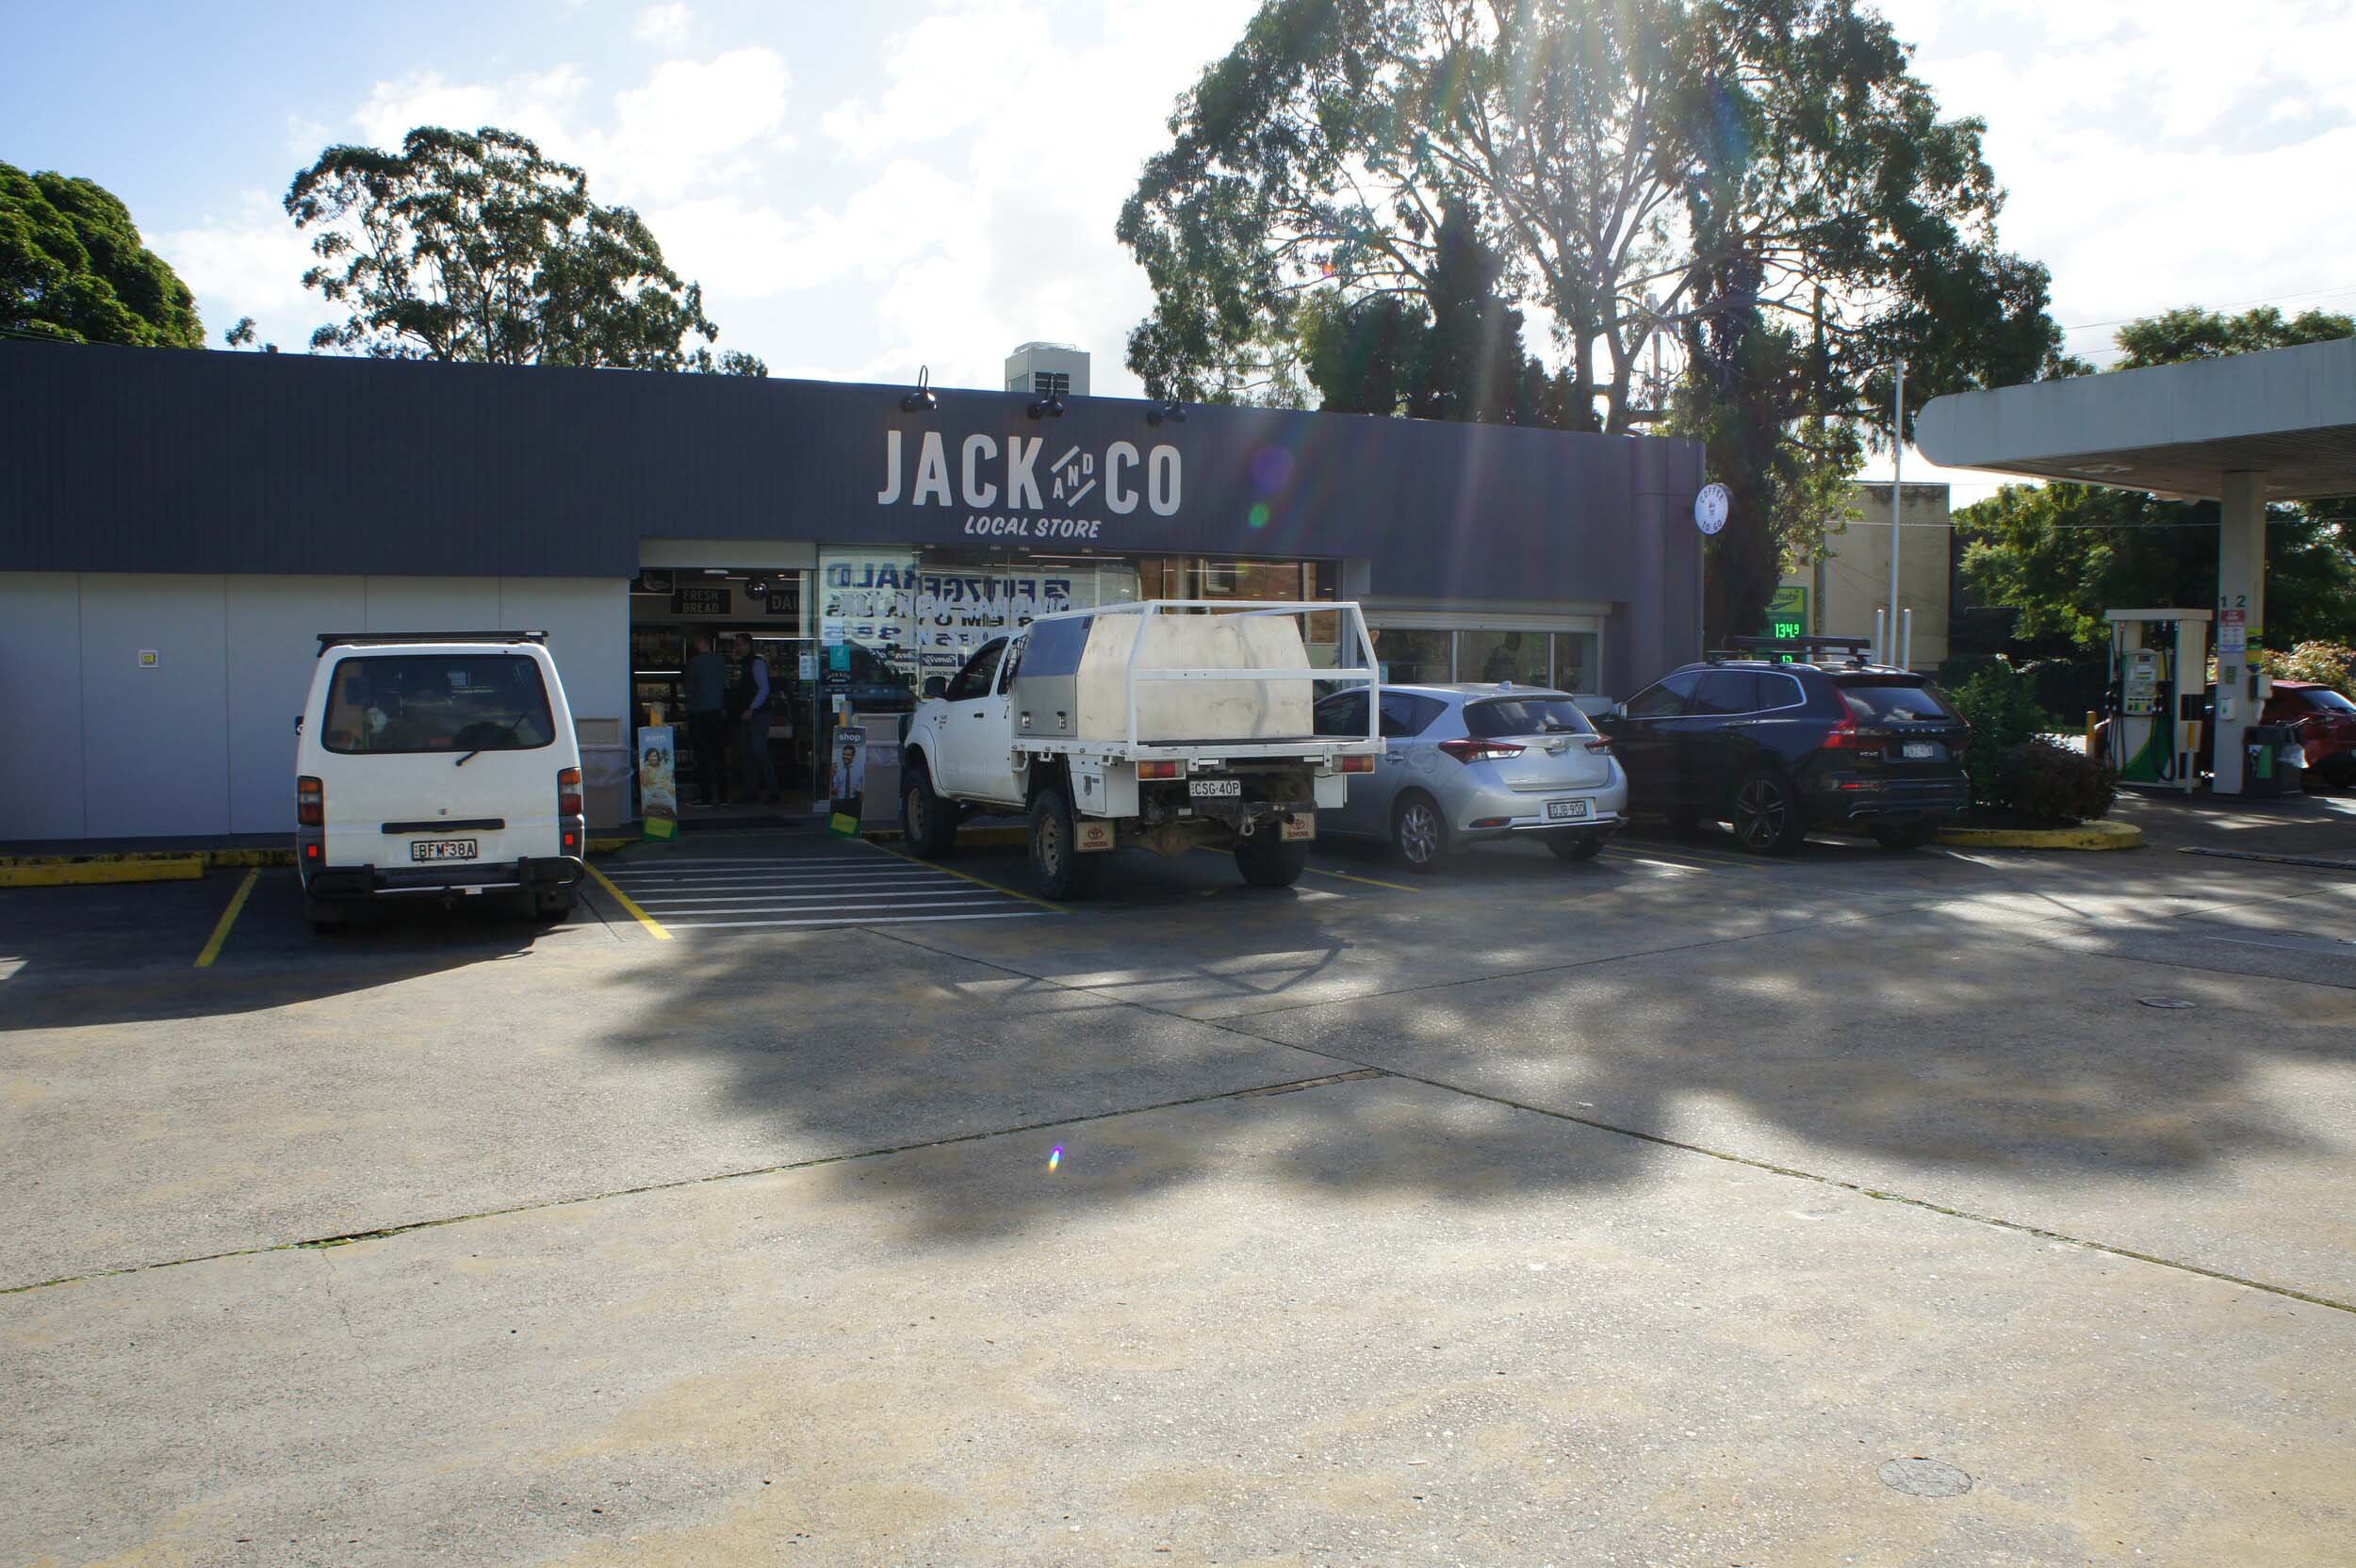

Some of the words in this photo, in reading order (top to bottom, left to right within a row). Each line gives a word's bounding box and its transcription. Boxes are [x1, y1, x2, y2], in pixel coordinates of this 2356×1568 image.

[877, 430, 1044, 511] JACK
[1052, 452, 1094, 499] AND
[1104, 440, 1182, 516] CO
[1699, 486, 1725, 504] COFFEE
[964, 514, 1030, 537] LOCAL
[1035, 517, 1102, 539] STORE
[1703, 520, 1710, 531] TO
[1713, 519, 1723, 531] GO
[683, 589, 719, 600] FRESH
[683, 602, 719, 613] BREAD
[771, 595, 799, 611] DAI
[2220, 595, 2227, 608] 1
[2236, 595, 2247, 608] 2
[839, 733, 860, 743] shop
